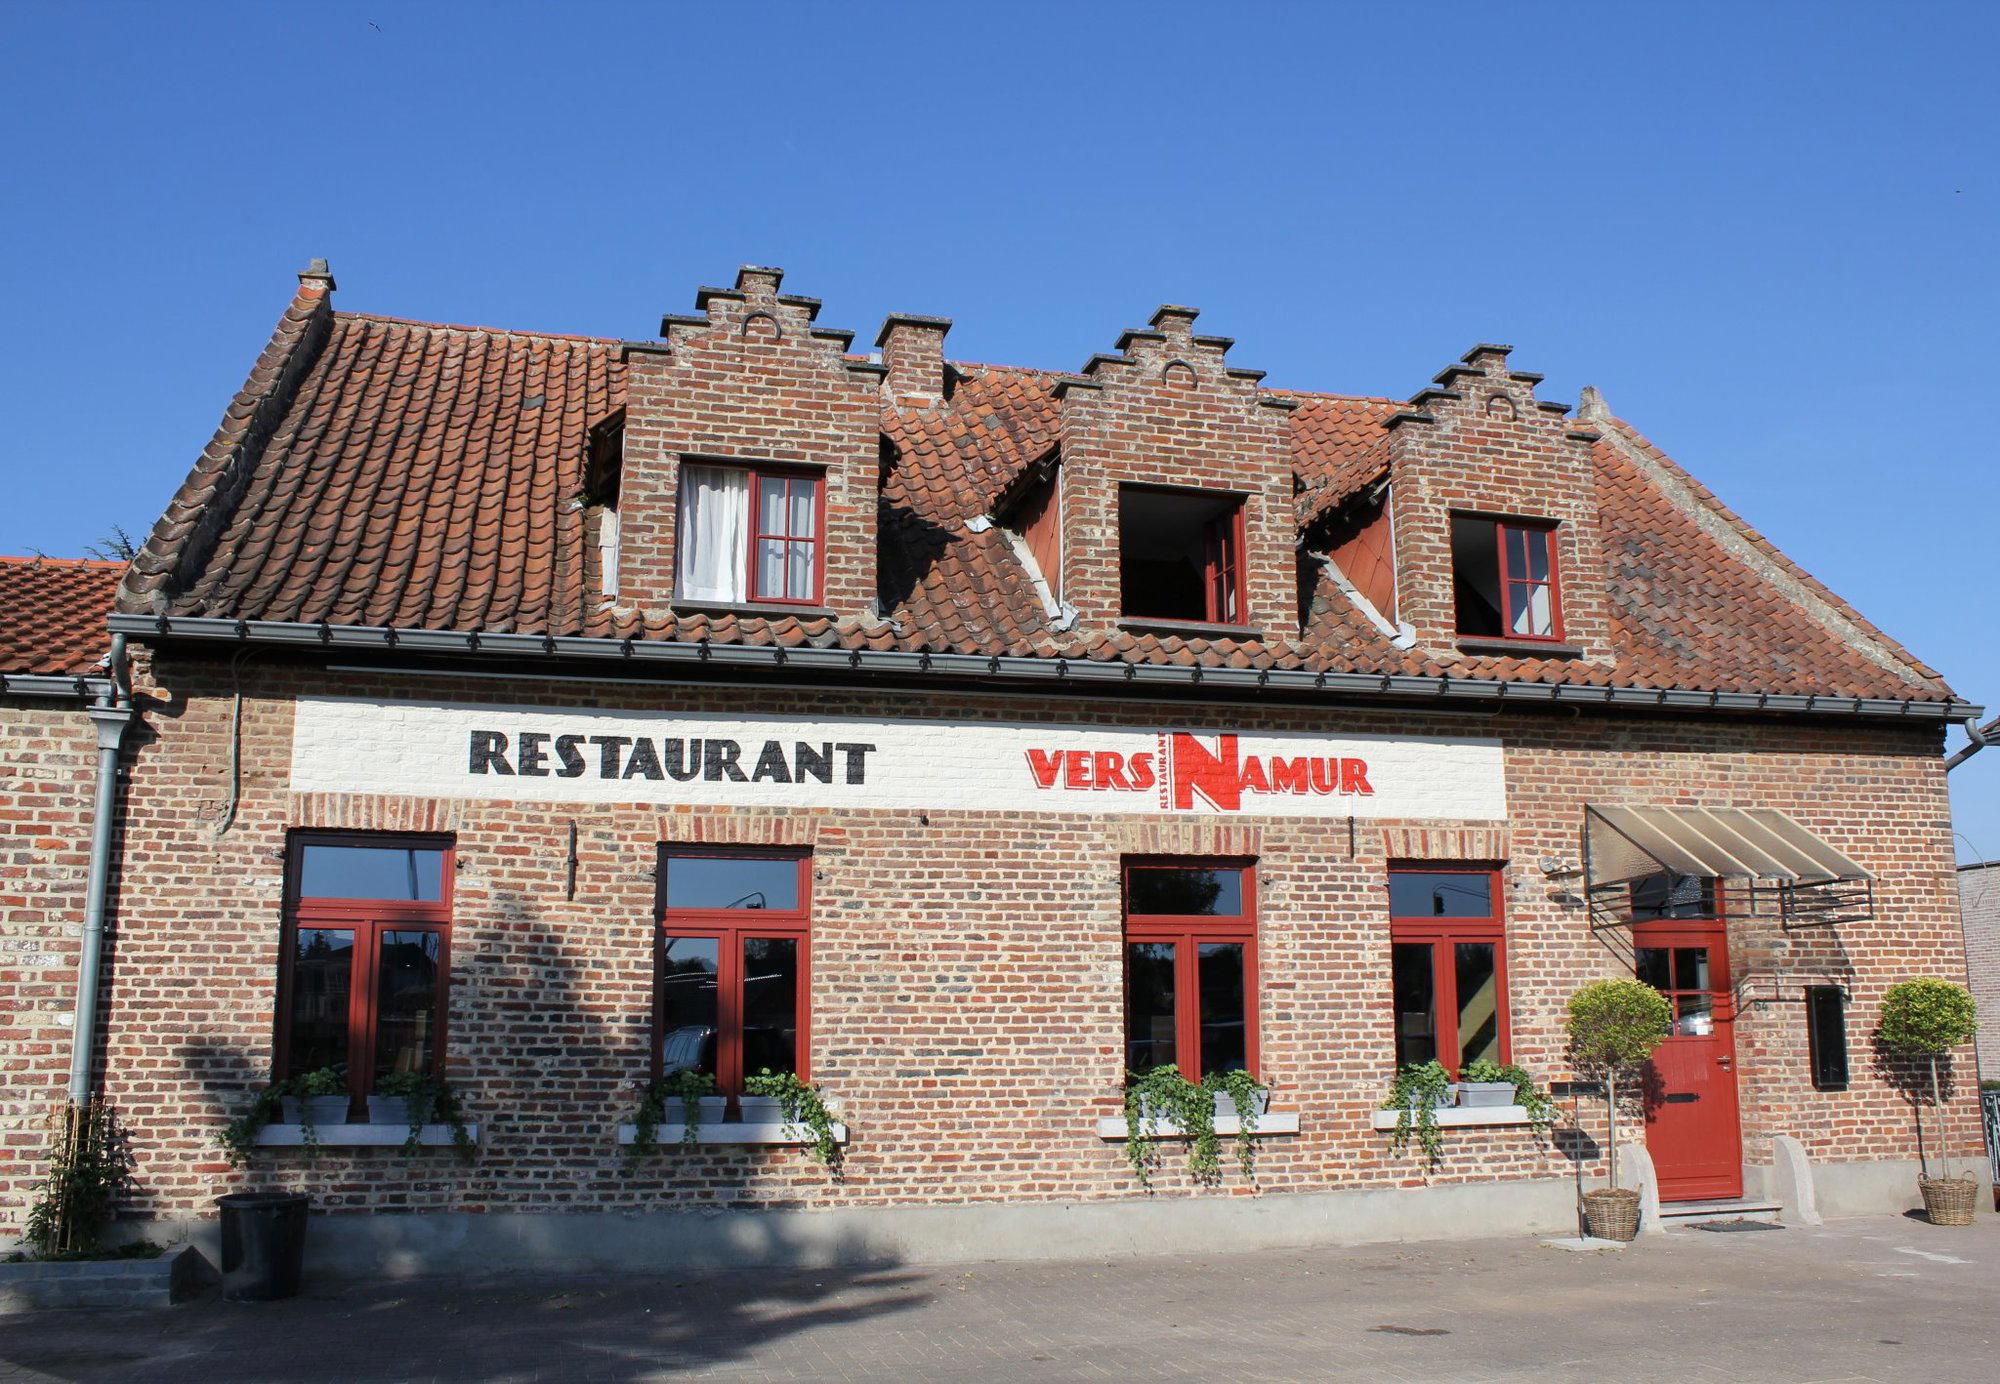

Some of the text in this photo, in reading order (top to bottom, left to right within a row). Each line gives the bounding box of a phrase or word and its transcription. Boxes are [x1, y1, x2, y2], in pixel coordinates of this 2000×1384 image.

[469, 730, 877, 785] RESTAURANT
[1024, 731, 1375, 812] VERS NAMUR
[1157, 730, 1169, 810] RESTAURANT
